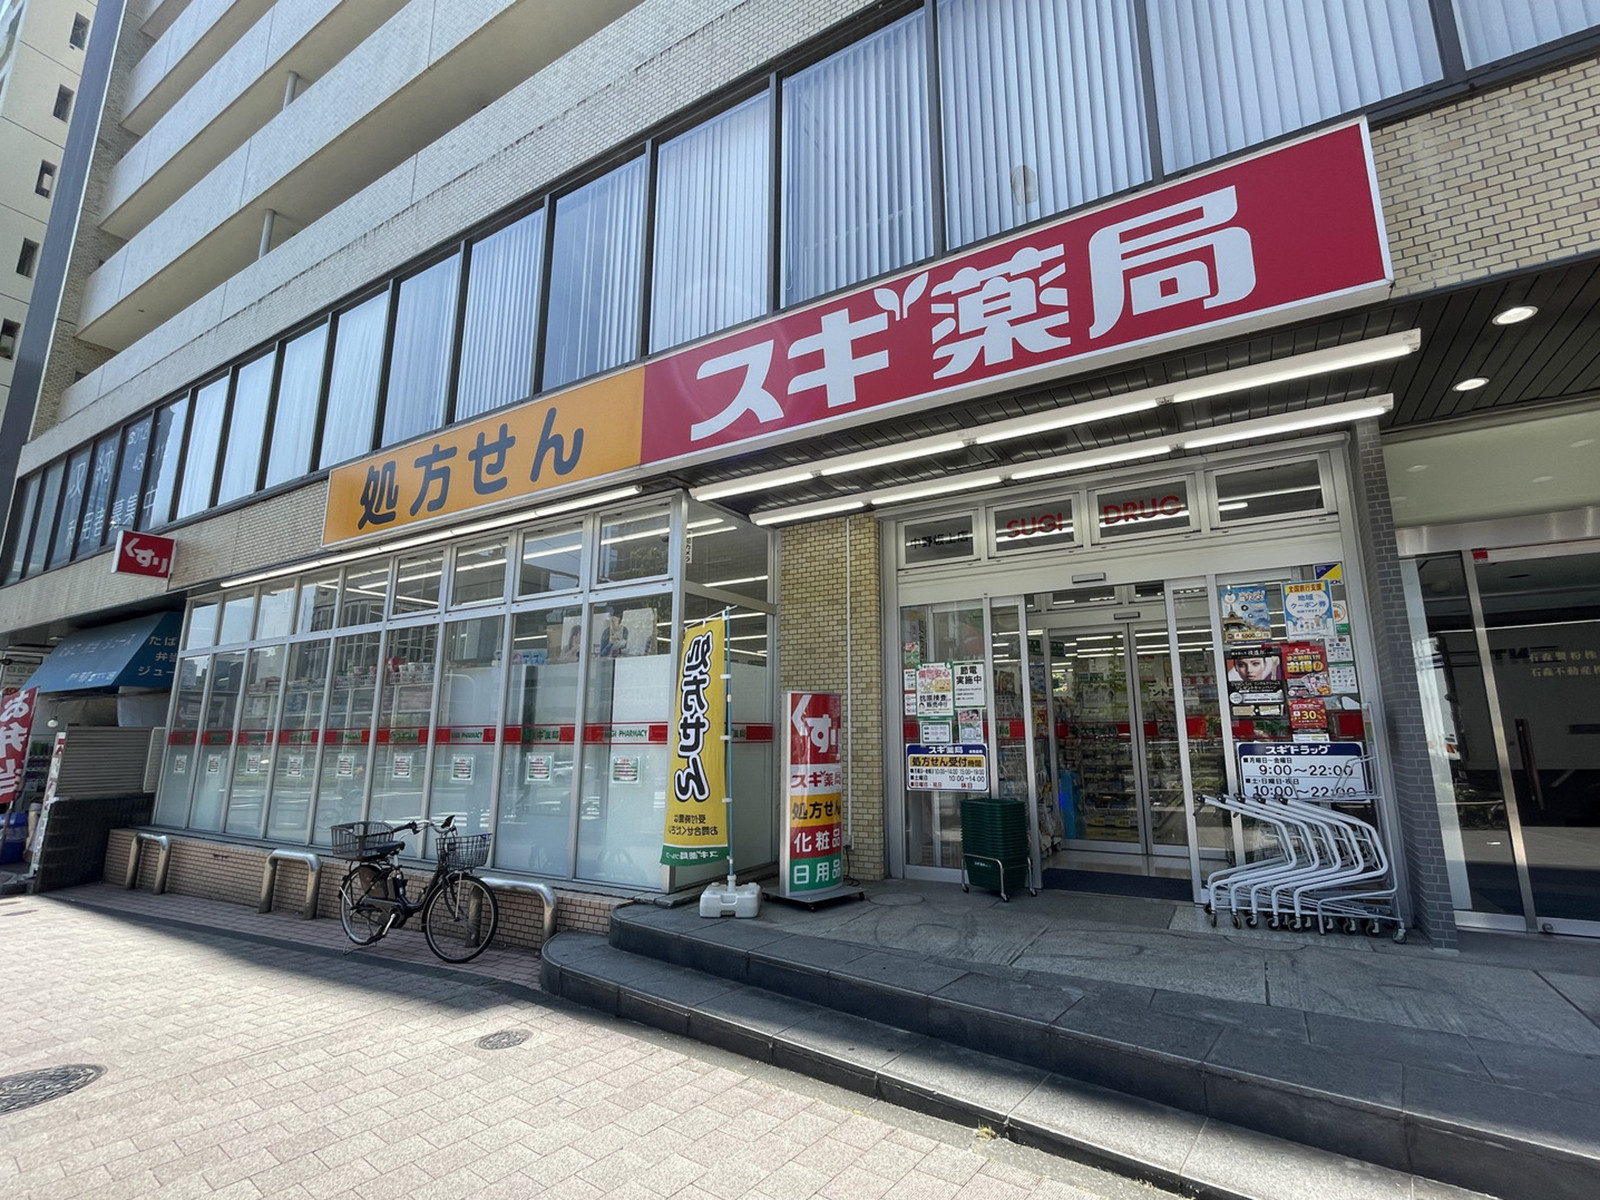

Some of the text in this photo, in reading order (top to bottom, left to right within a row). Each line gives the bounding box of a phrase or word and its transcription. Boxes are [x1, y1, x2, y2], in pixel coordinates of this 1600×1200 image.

[690, 185, 1257, 441] スギ薬局
[358, 407, 585, 530] 処方せん
[1104, 495, 1182, 525] DRUG
[1006, 512, 1063, 538] SUGI
[125, 537, 168, 574] くすり
[1290, 601, 1326, 610] クーポン券
[960, 665, 978, 675] 節電
[956, 675, 982, 685] 実施中
[1302, 710, 1317, 720] 30
[618, 729, 648, 738] PHARMACY
[792, 695, 841, 761] くすり
[928, 745, 964, 755] スギ薬局
[1265, 744, 1331, 755] スギドラッグ
[791, 771, 841, 789] スギ薬局
[792, 802, 841, 820] 処方せん
[794, 828, 841, 852] 化粧品
[793, 861, 841, 885] 日用品
